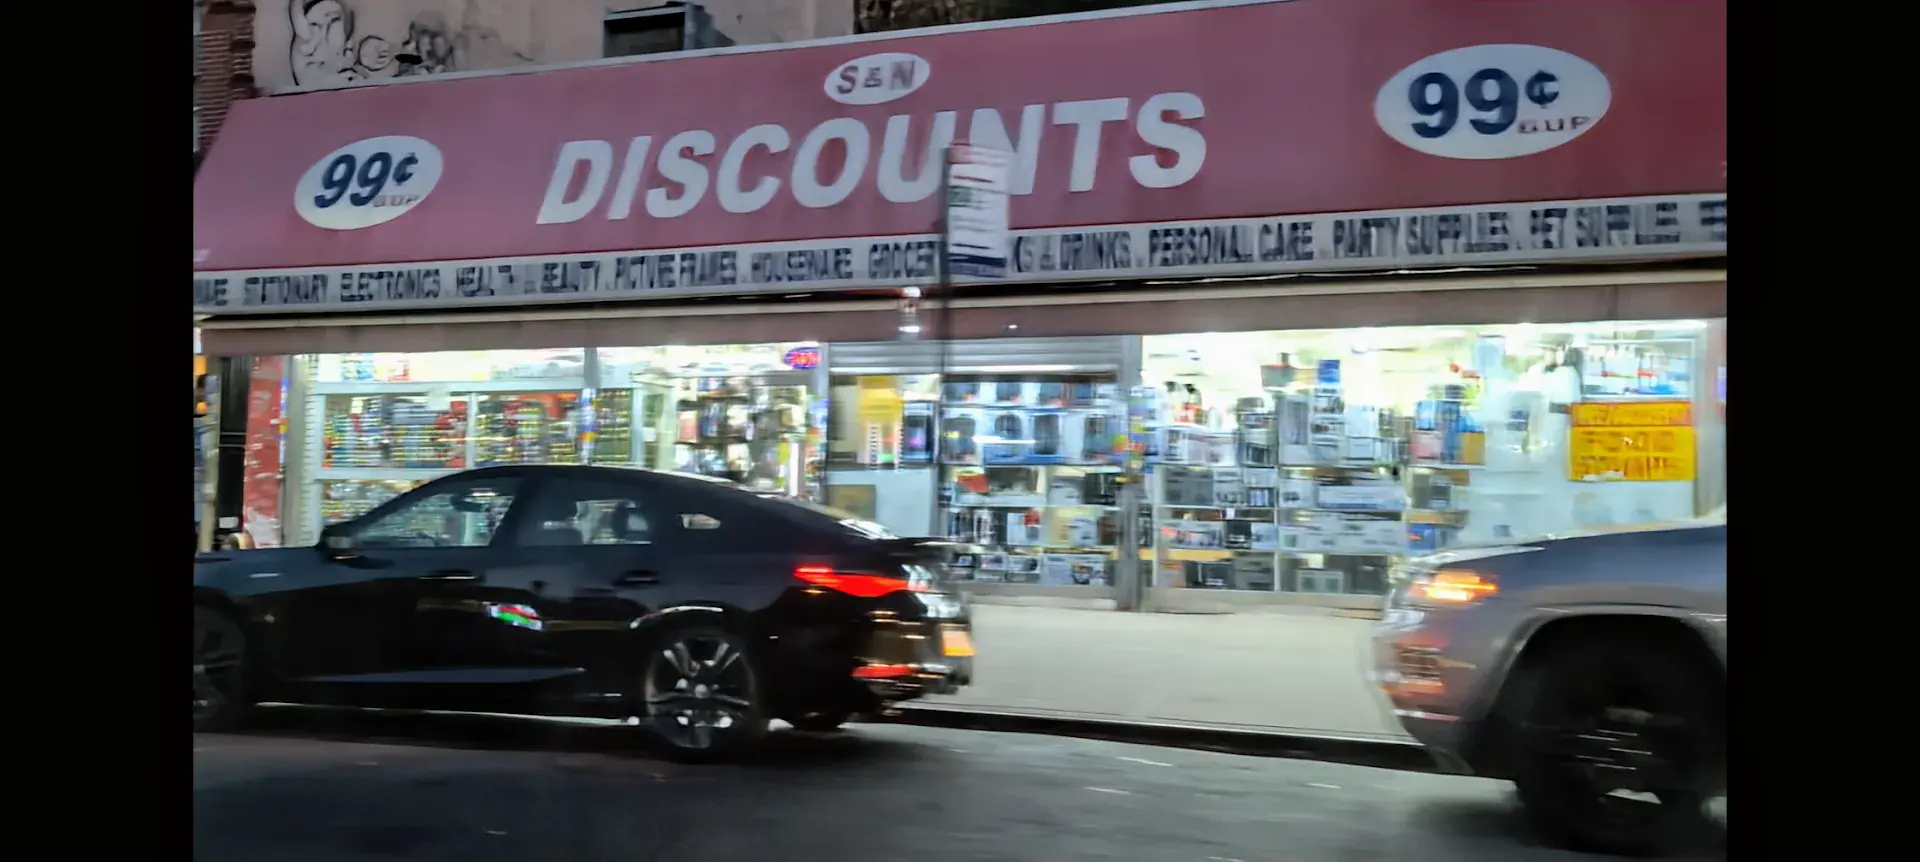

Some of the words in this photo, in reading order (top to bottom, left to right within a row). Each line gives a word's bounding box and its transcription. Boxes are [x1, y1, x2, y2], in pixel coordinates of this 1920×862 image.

[535, 92, 1207, 225] DISCOUNTS
[1148, 224, 1253, 266] PERSONAL
[1259, 221, 1314, 261] CARE
[1334, 217, 1400, 259] PARTY
